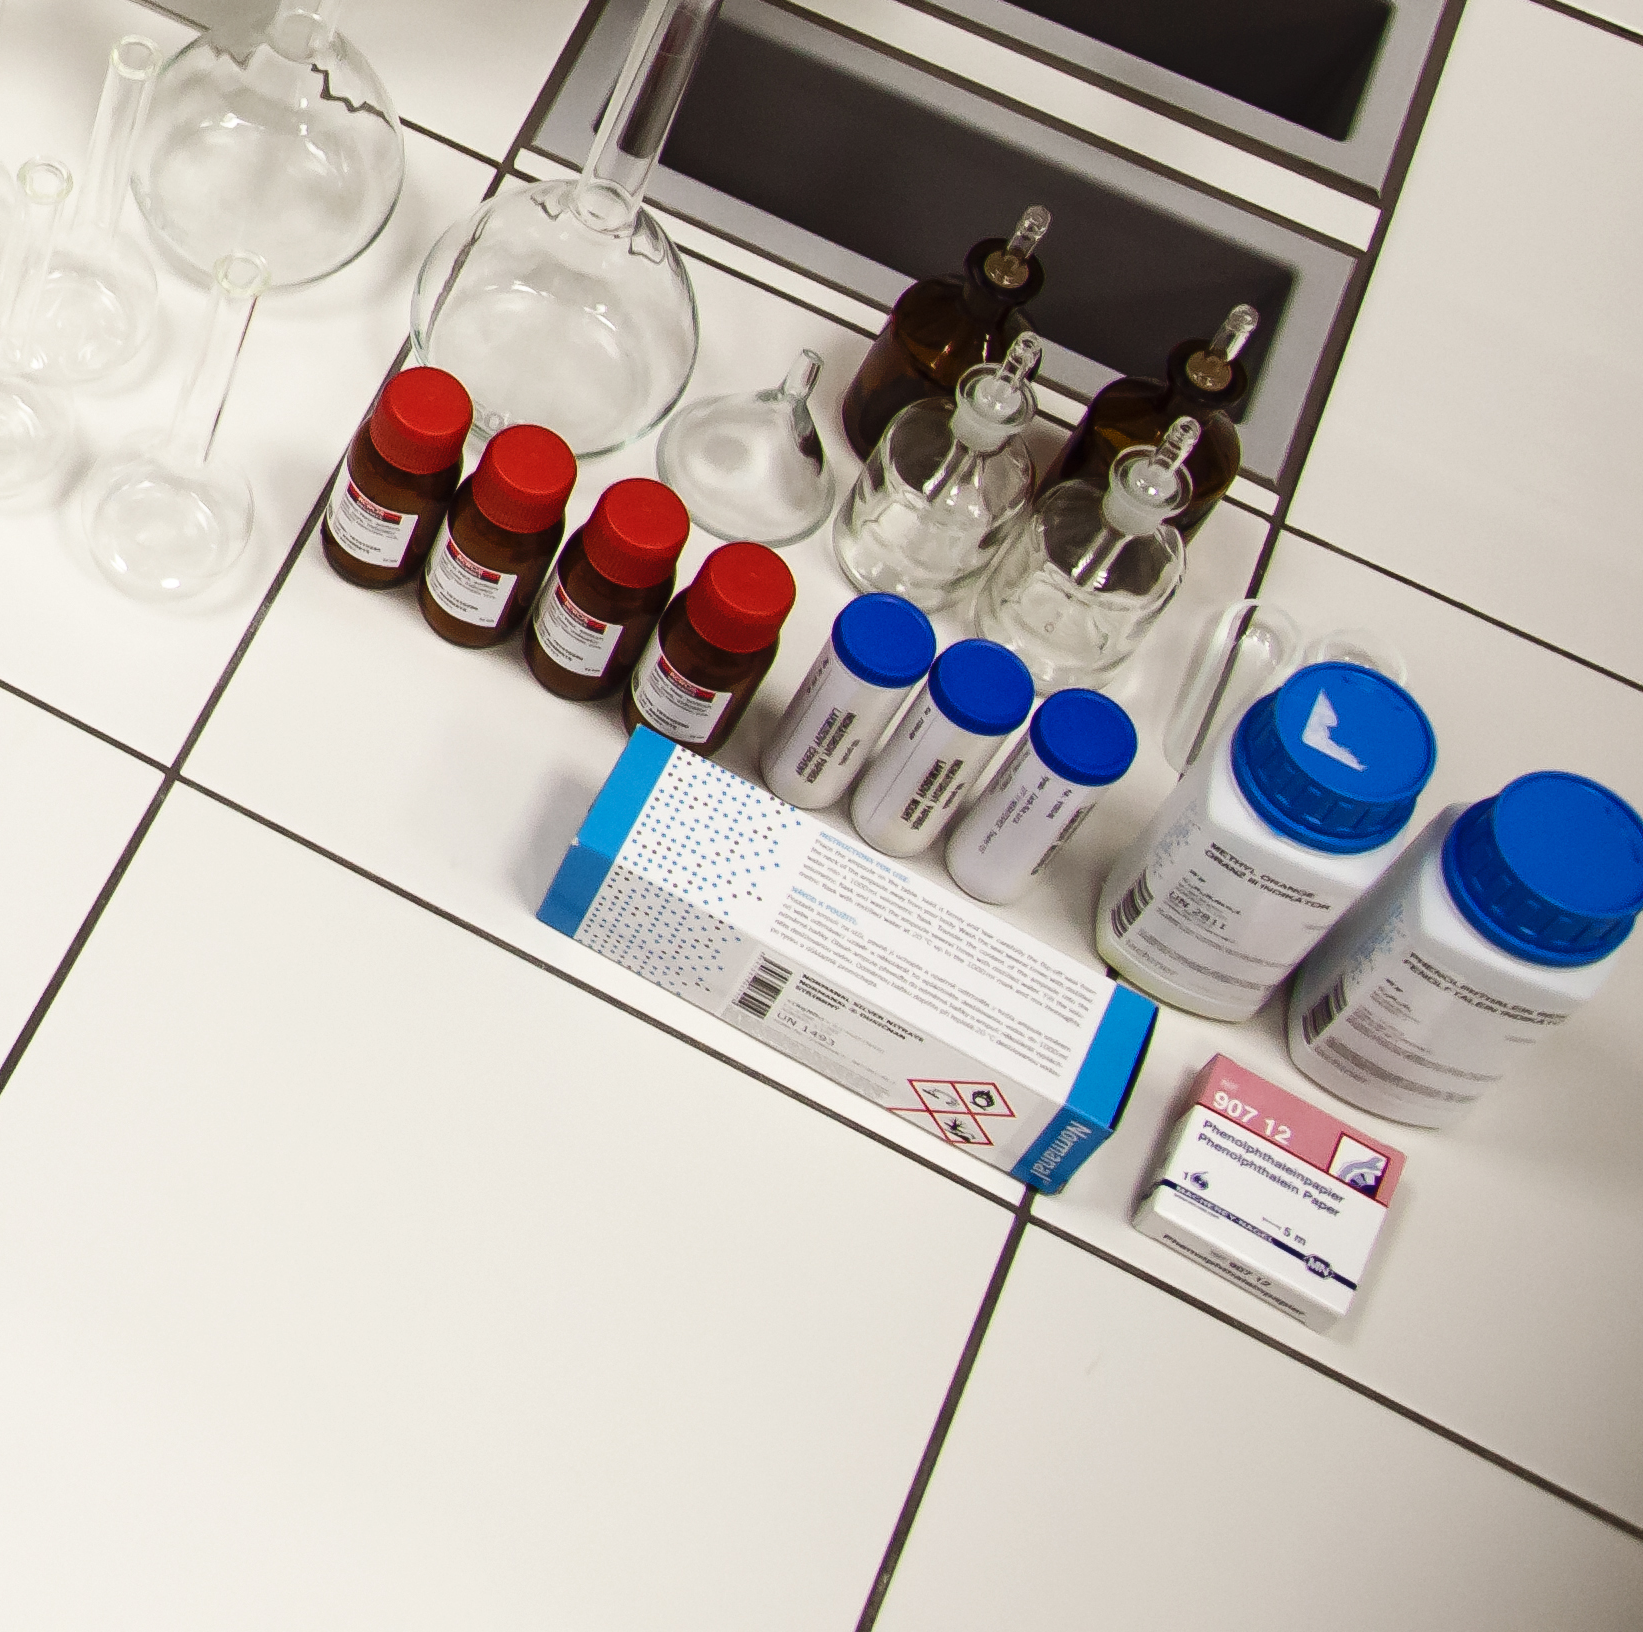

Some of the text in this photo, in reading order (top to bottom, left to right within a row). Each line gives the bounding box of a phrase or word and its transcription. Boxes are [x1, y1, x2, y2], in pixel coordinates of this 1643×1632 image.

[1211, 841, 1255, 874] METHYL
[775, 1011, 836, 1047] UN 1493
[1212, 1091, 1293, 1144] 907 12
[1030, 1120, 1092, 1183] Normanal
[1197, 1132, 1340, 1217] Phenolphthalein Paper
[1203, 1119, 1345, 1204] Phenolphthaleinpapier
[1283, 1227, 1307, 1246] 5 m
